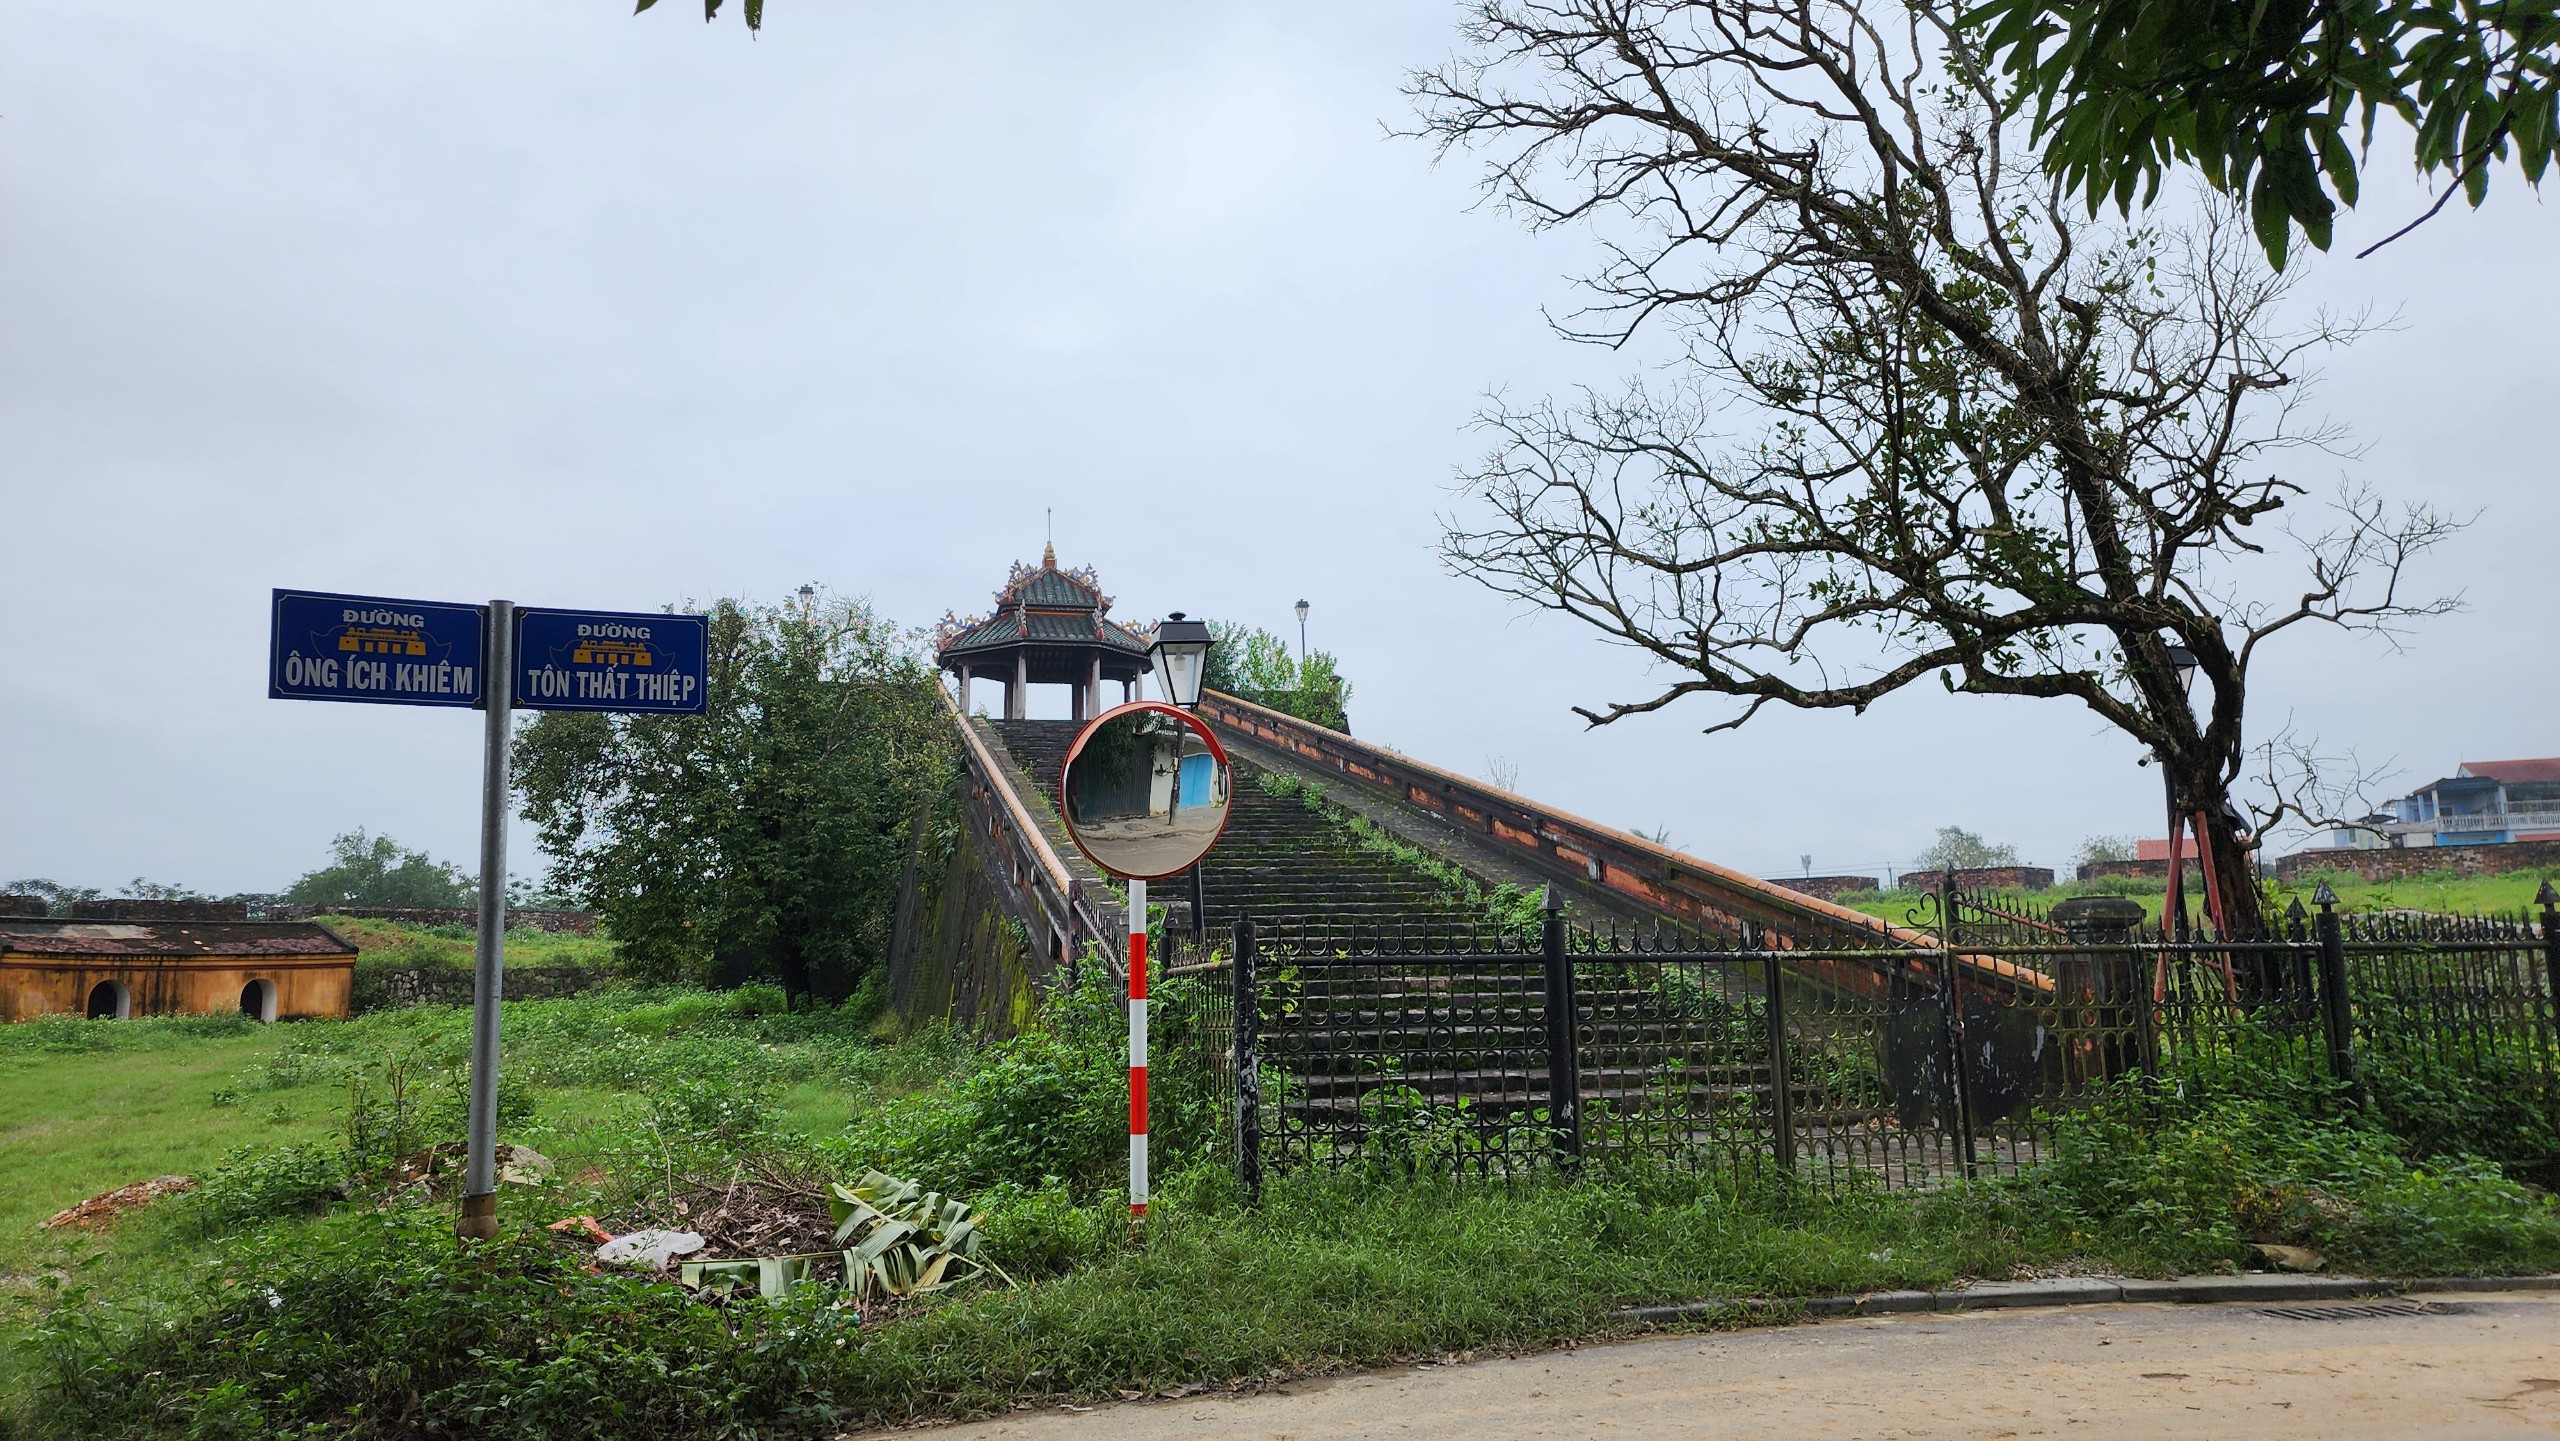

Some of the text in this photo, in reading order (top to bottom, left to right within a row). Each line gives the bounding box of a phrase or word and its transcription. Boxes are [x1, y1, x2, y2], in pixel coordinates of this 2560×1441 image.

[343, 608, 425, 628] ĐƯỜNG
[577, 622, 651, 640] ĐƯỜNG
[285, 650, 473, 694] ÔNG ÍCH KHIÊM
[528, 662, 696, 706] TÔN THẤT THIỆP
